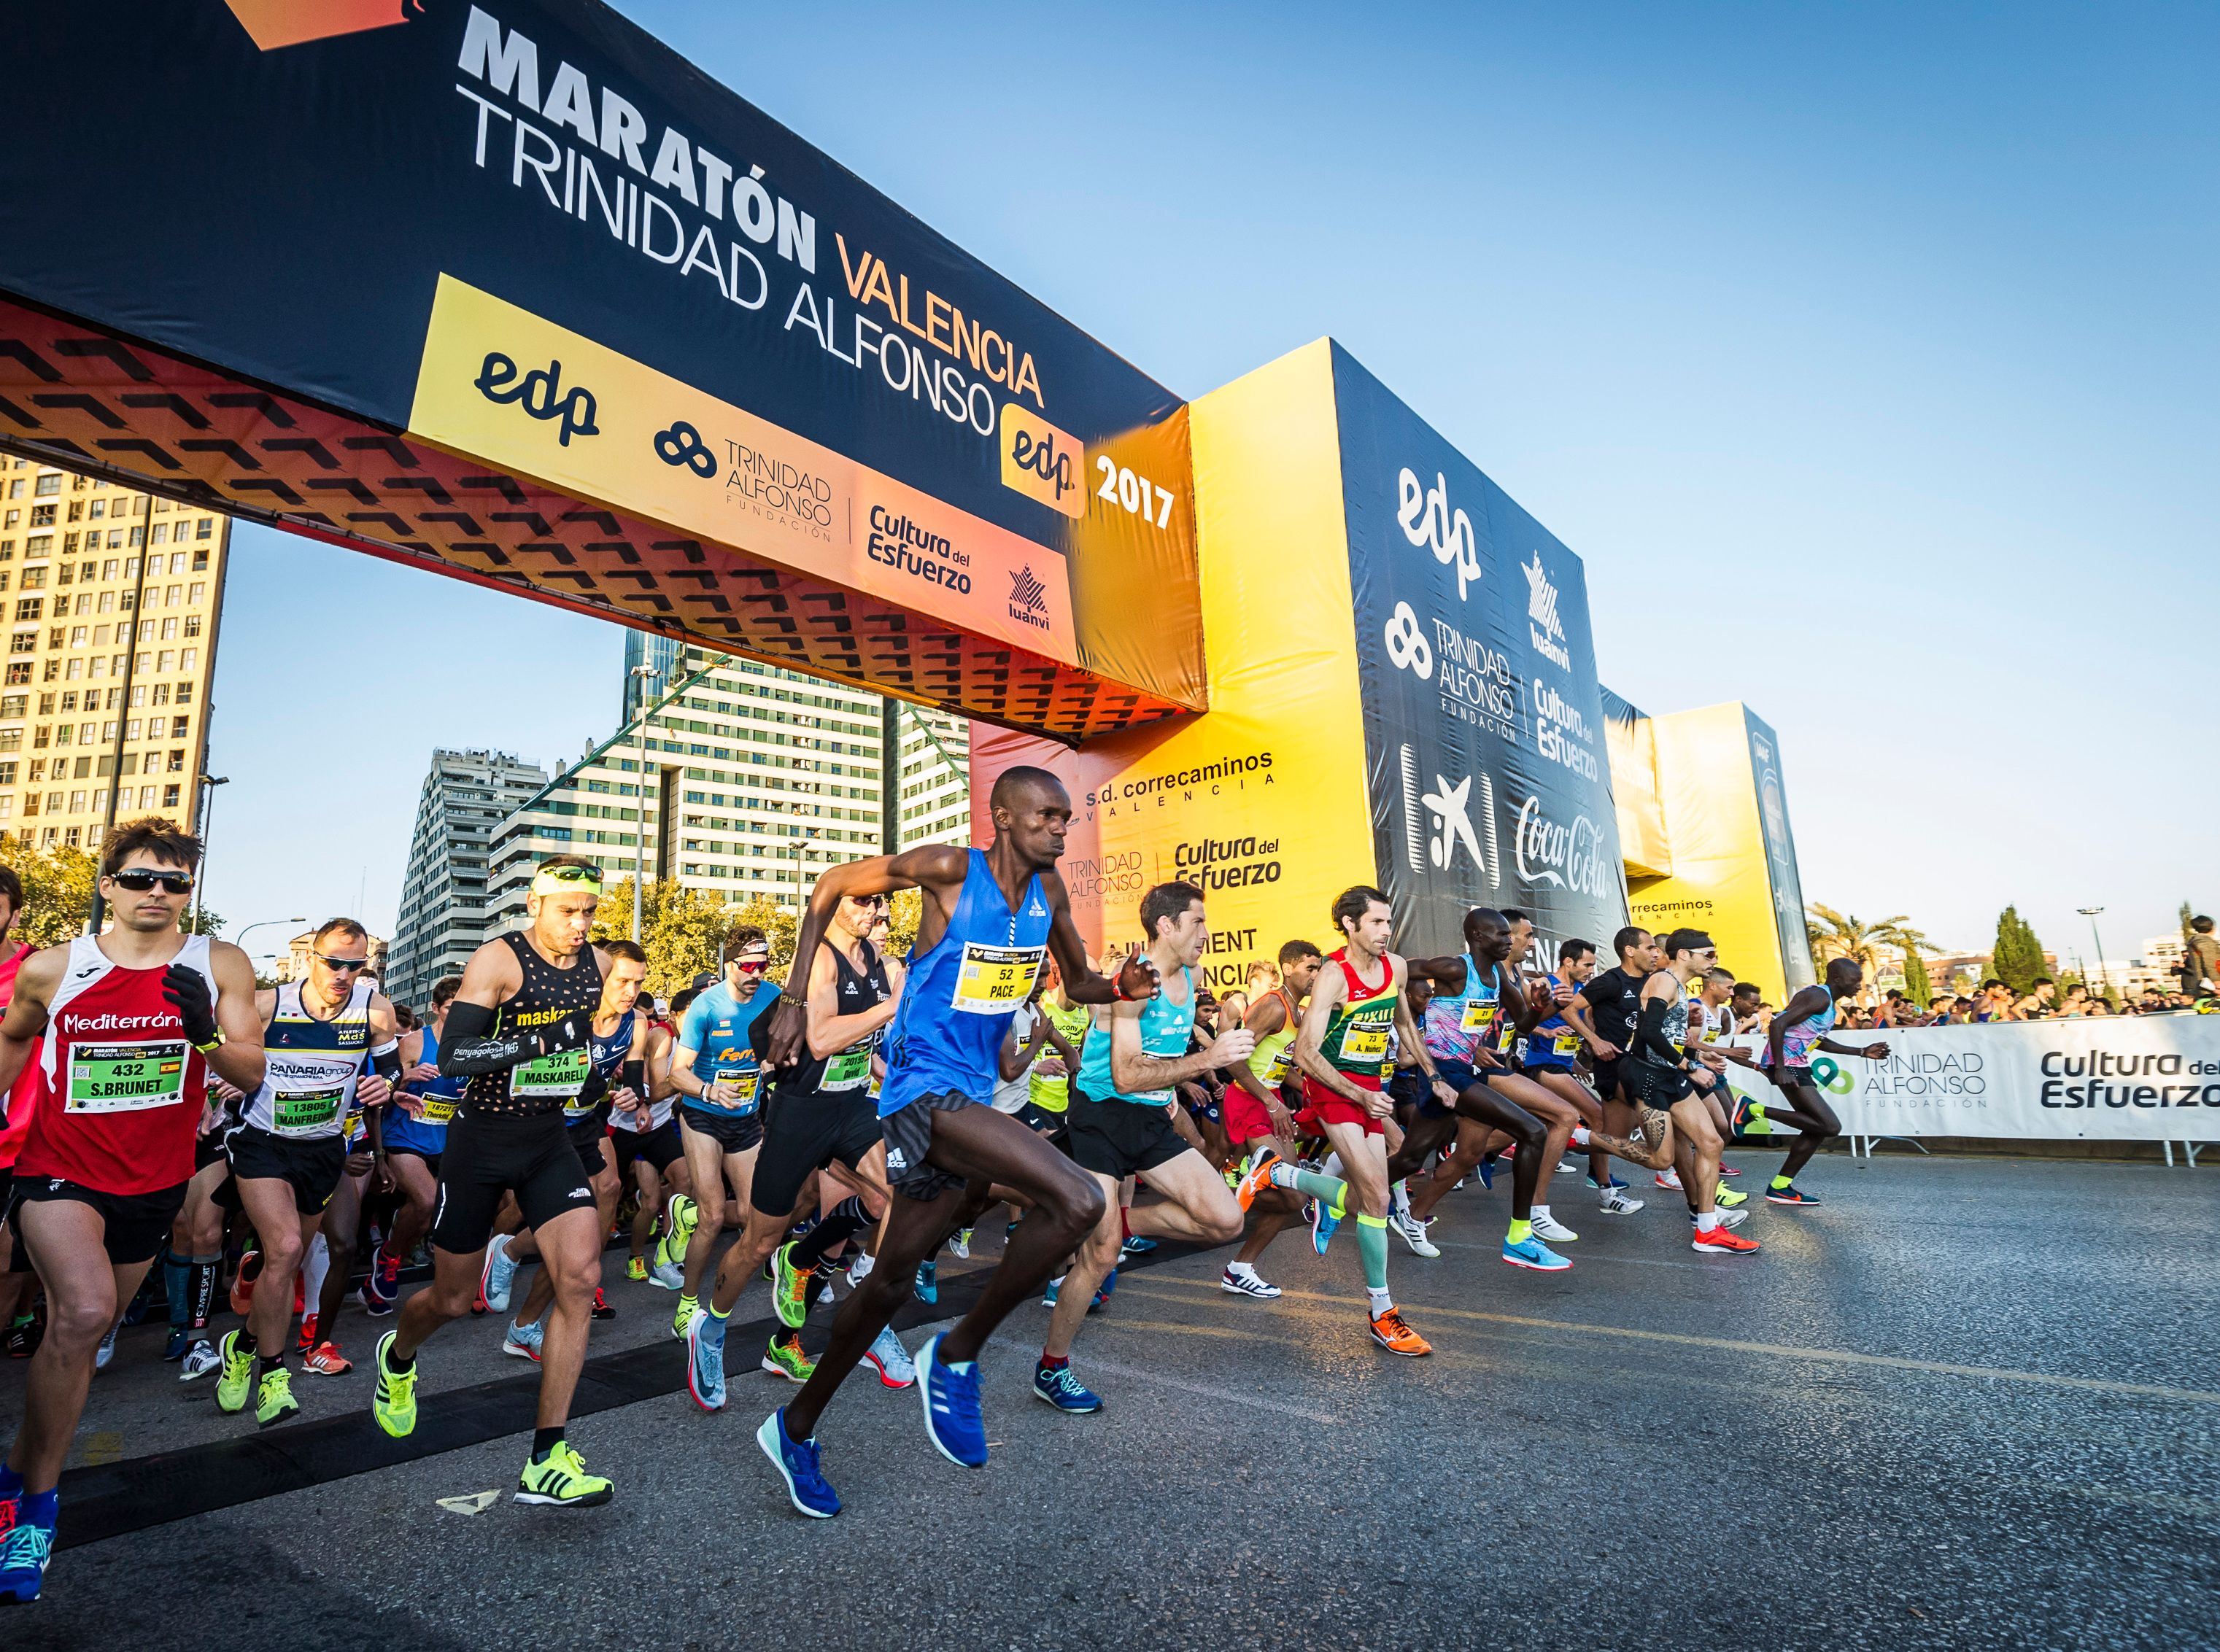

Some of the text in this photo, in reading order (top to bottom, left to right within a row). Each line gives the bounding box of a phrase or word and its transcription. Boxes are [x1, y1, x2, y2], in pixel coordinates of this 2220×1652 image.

[458, 4, 1044, 408] MARATÓN VALENCIA
[456, 83, 1175, 530] TRINIDAD ALFONSO edp 2017
[473, 352, 600, 447] edp
[725, 439, 831, 503] TRINIDAD
[727, 470, 831, 527] ALFONSO
[727, 495, 830, 543] FUNDACIÓN
[870, 505, 970, 567] Cultura del
[1397, 467, 1482, 602] edp
[867, 532, 972, 594] Esfuerzo
[1009, 603, 1051, 631] luanvi
[1432, 617, 1510, 686] TRINIDAD
[1439, 659, 1514, 720] ALFONSO
[1442, 698, 1516, 742] FUNDACIÓN
[1533, 678, 1593, 745] Cultura del
[1536, 716, 1598, 783] Esfuerzo
[1086, 752, 1273, 807] s.d. correcaminos
[1086, 773, 1275, 822] VALENCIA
[1175, 837, 1279, 868] Cultura del
[1515, 795, 1607, 899] Coca-Cola
[1067, 851, 1142, 880] TRINIDAD
[1069, 872, 1143, 899] ALFONSO
[999, 969, 1013, 980] 52
[989, 985, 1015, 998] PACE
[63, 1011, 184, 1034] Mediterrán
[548, 1056, 570, 1069] 374
[1355, 1044, 1363, 1052] A.
[112, 1063, 144, 1077] 432
[525, 1069, 585, 1084] MASKARELL
[843, 1067, 860, 1079] David
[1865, 1053, 1984, 1074] TRINIDAD
[2041, 1050, 2183, 1077] Cultura
[90, 1079, 163, 1097] S.BRUNET
[1865, 1076, 1986, 1095] ALFONSO
[2041, 1079, 2220, 1108] Esfuerzo
[293, 1101, 327, 1112] 13805
[1866, 1098, 1987, 1108] FUNDACIÓN
